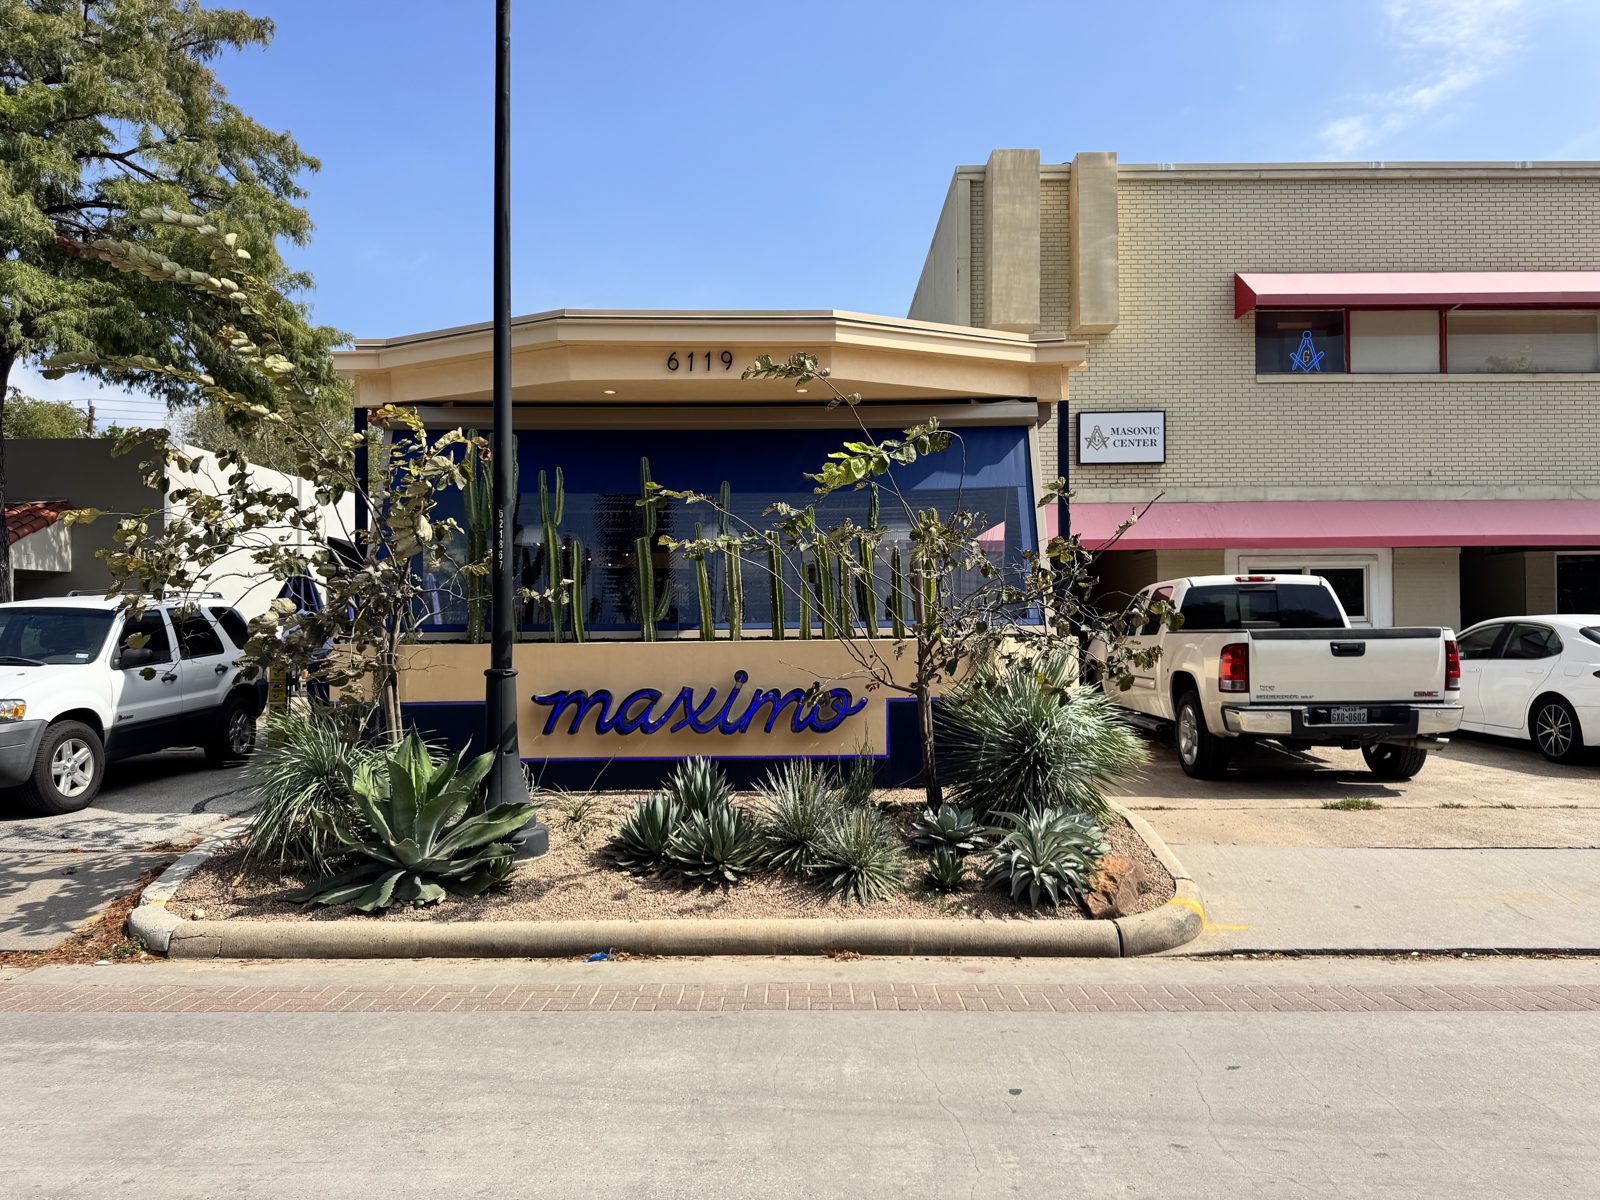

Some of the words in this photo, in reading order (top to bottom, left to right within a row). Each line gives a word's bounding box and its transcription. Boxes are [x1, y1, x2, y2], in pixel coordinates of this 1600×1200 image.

[667, 350, 733, 372] 6119
[1302, 350, 1311, 362] G
[1110, 427, 1160, 436] MASONIC
[1112, 438, 1157, 448] CENTER
[531, 670, 868, 736] maximo
